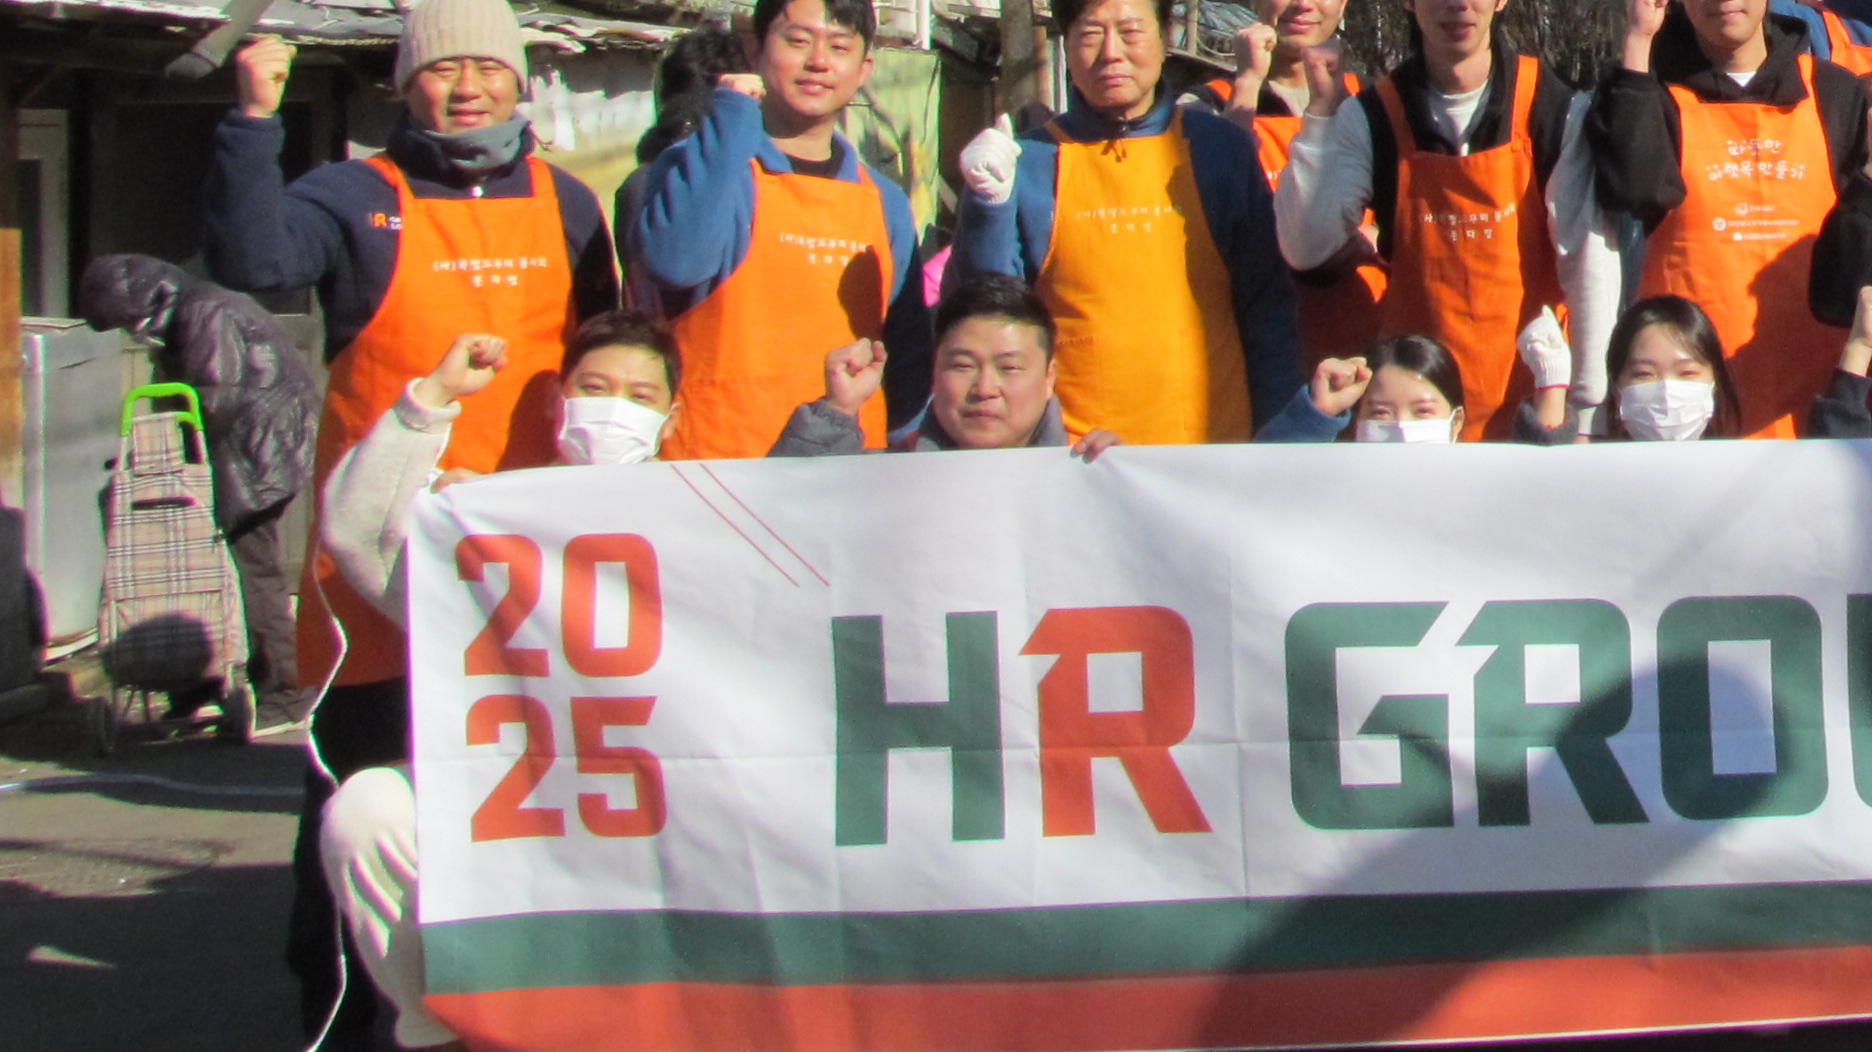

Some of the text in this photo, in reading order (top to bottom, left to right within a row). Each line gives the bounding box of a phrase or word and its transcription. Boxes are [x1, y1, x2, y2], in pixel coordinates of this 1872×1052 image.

[454, 532, 663, 678] 20
[465, 693, 668, 843] 25
[830, 604, 1214, 847] HR
